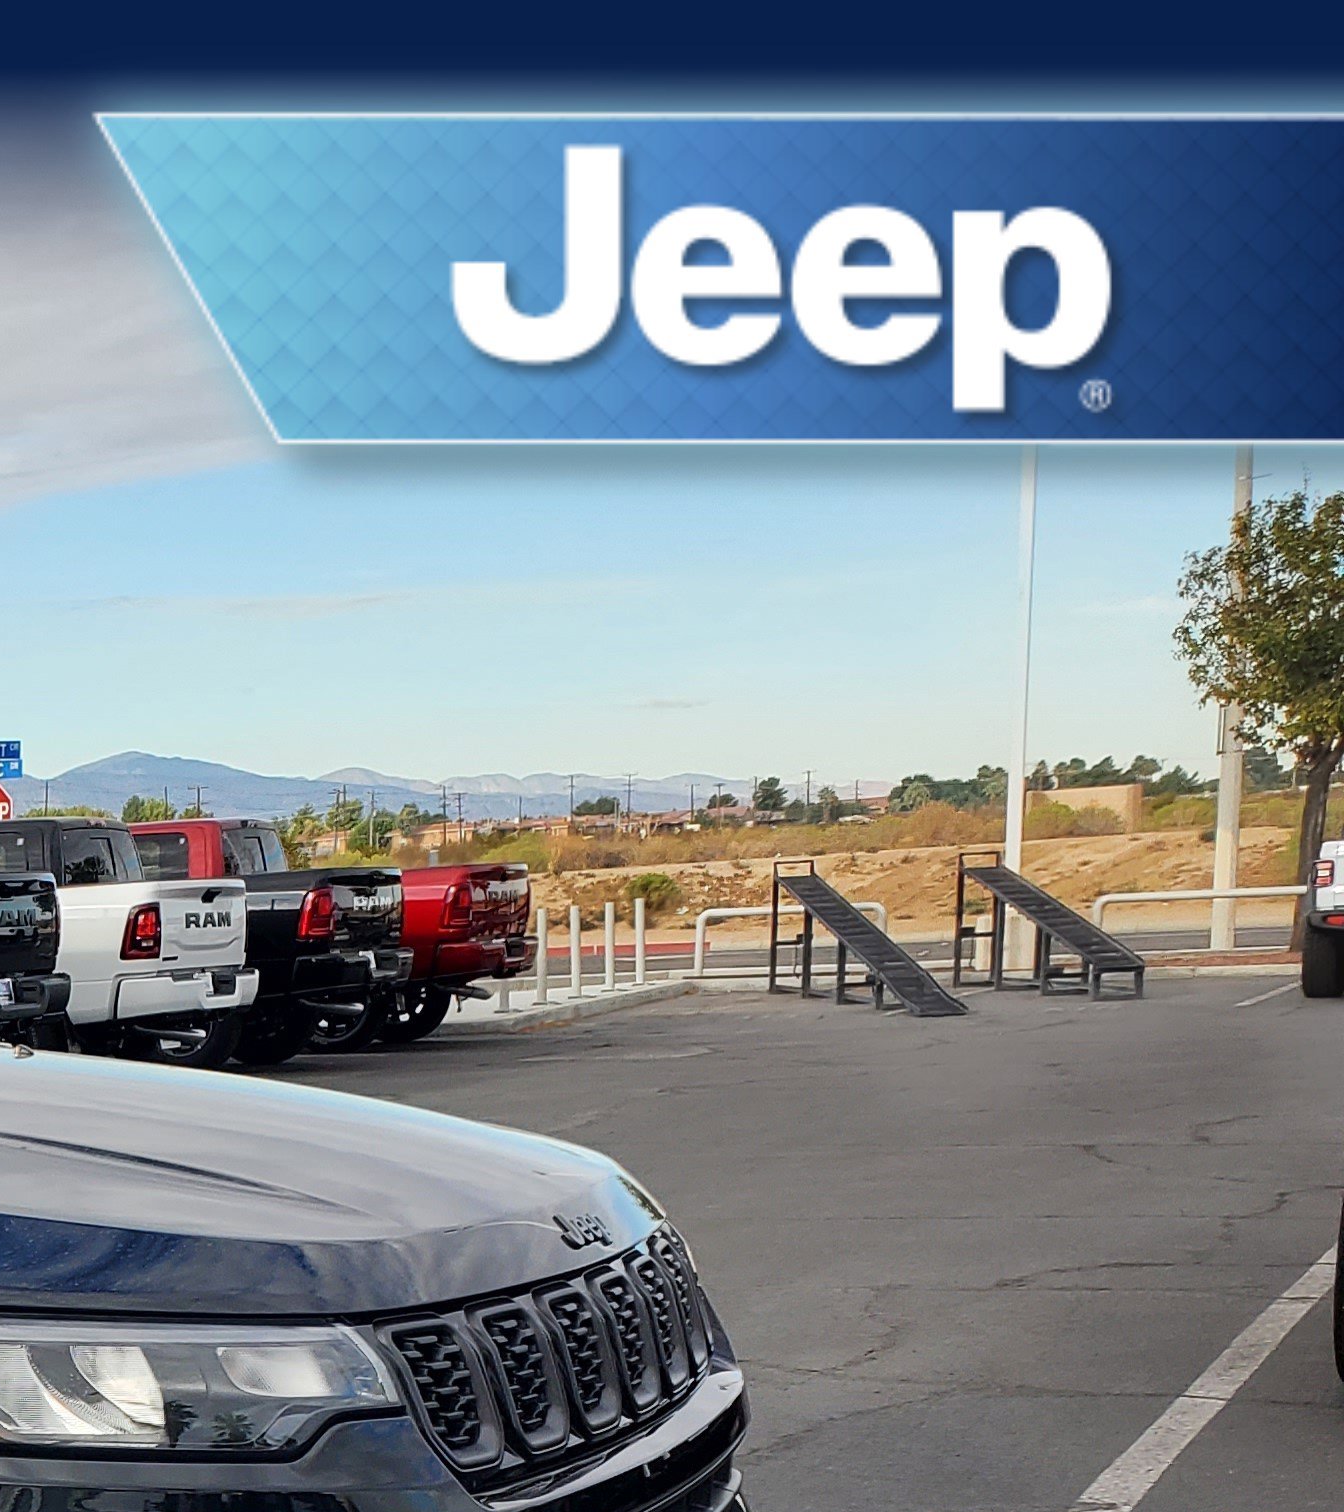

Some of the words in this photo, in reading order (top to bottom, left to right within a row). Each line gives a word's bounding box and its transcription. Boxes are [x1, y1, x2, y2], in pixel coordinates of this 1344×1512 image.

[353, 896, 392, 911] RAM
[184, 911, 232, 929] RAM
[552, 1212, 613, 1251] Jeep
